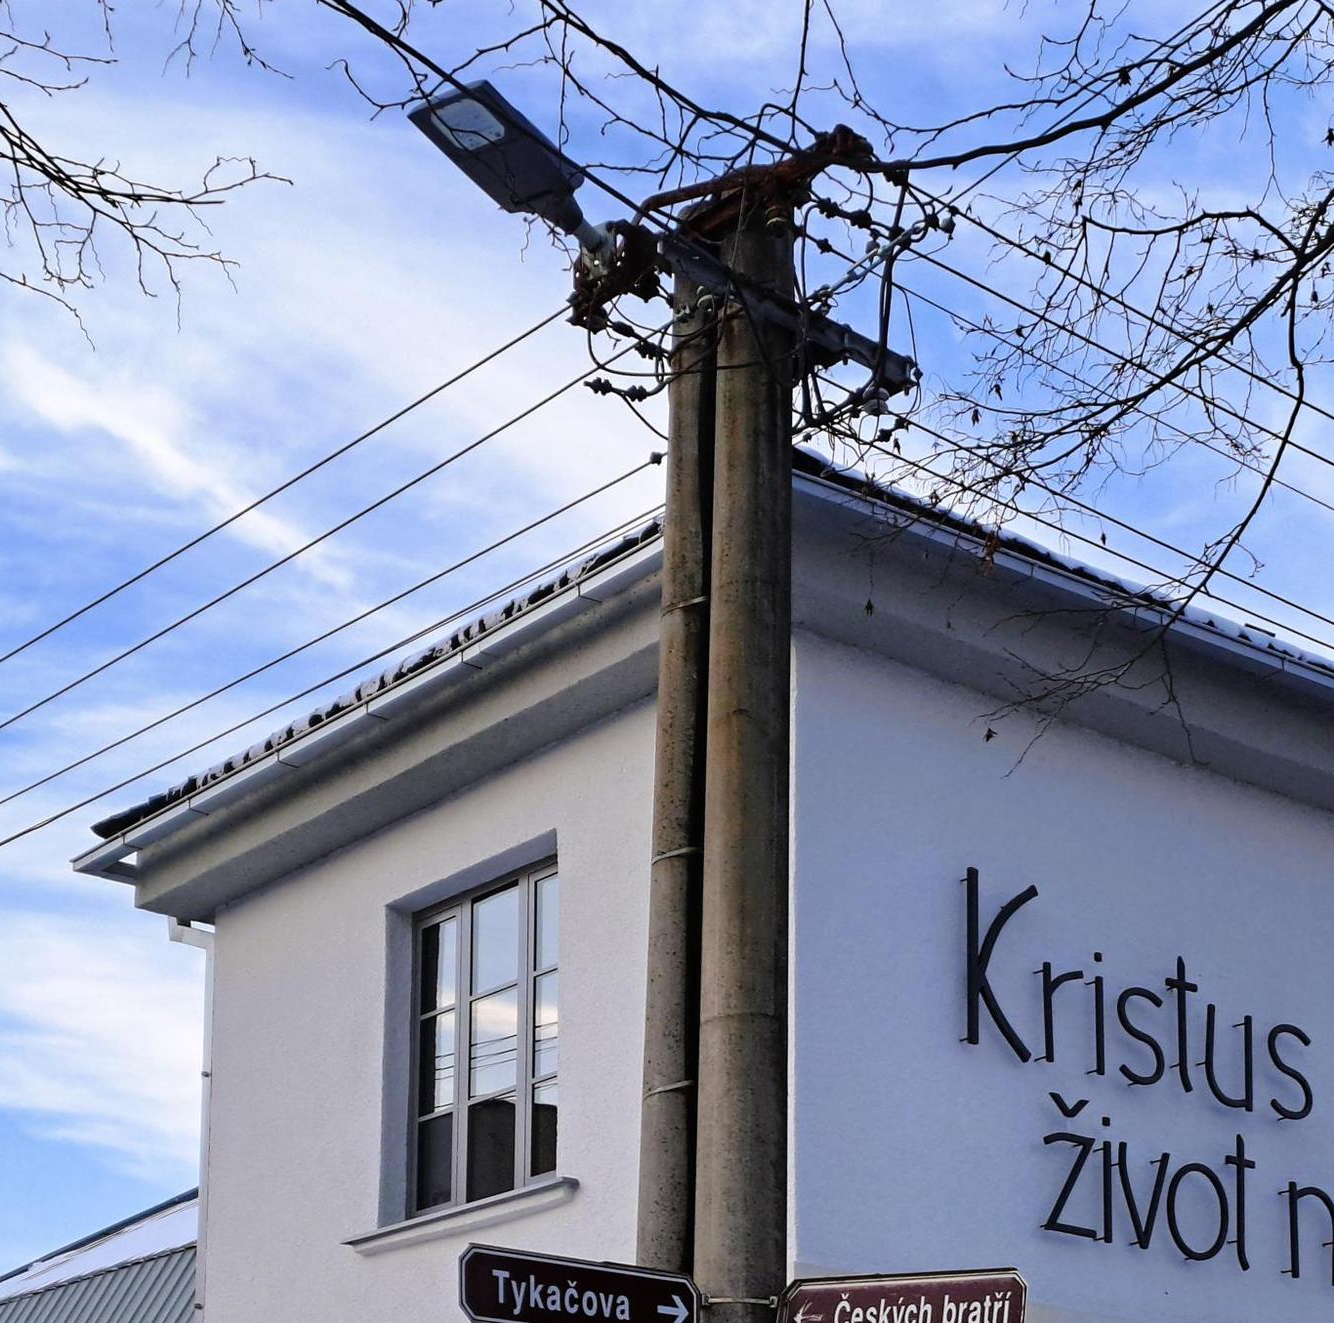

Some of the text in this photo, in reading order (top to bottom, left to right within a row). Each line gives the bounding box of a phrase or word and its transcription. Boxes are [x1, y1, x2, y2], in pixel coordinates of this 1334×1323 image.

[966, 866, 1314, 1121] Kristus
[1043, 1091, 1256, 1271] život
[491, 1268, 631, 1322] Tykačova
